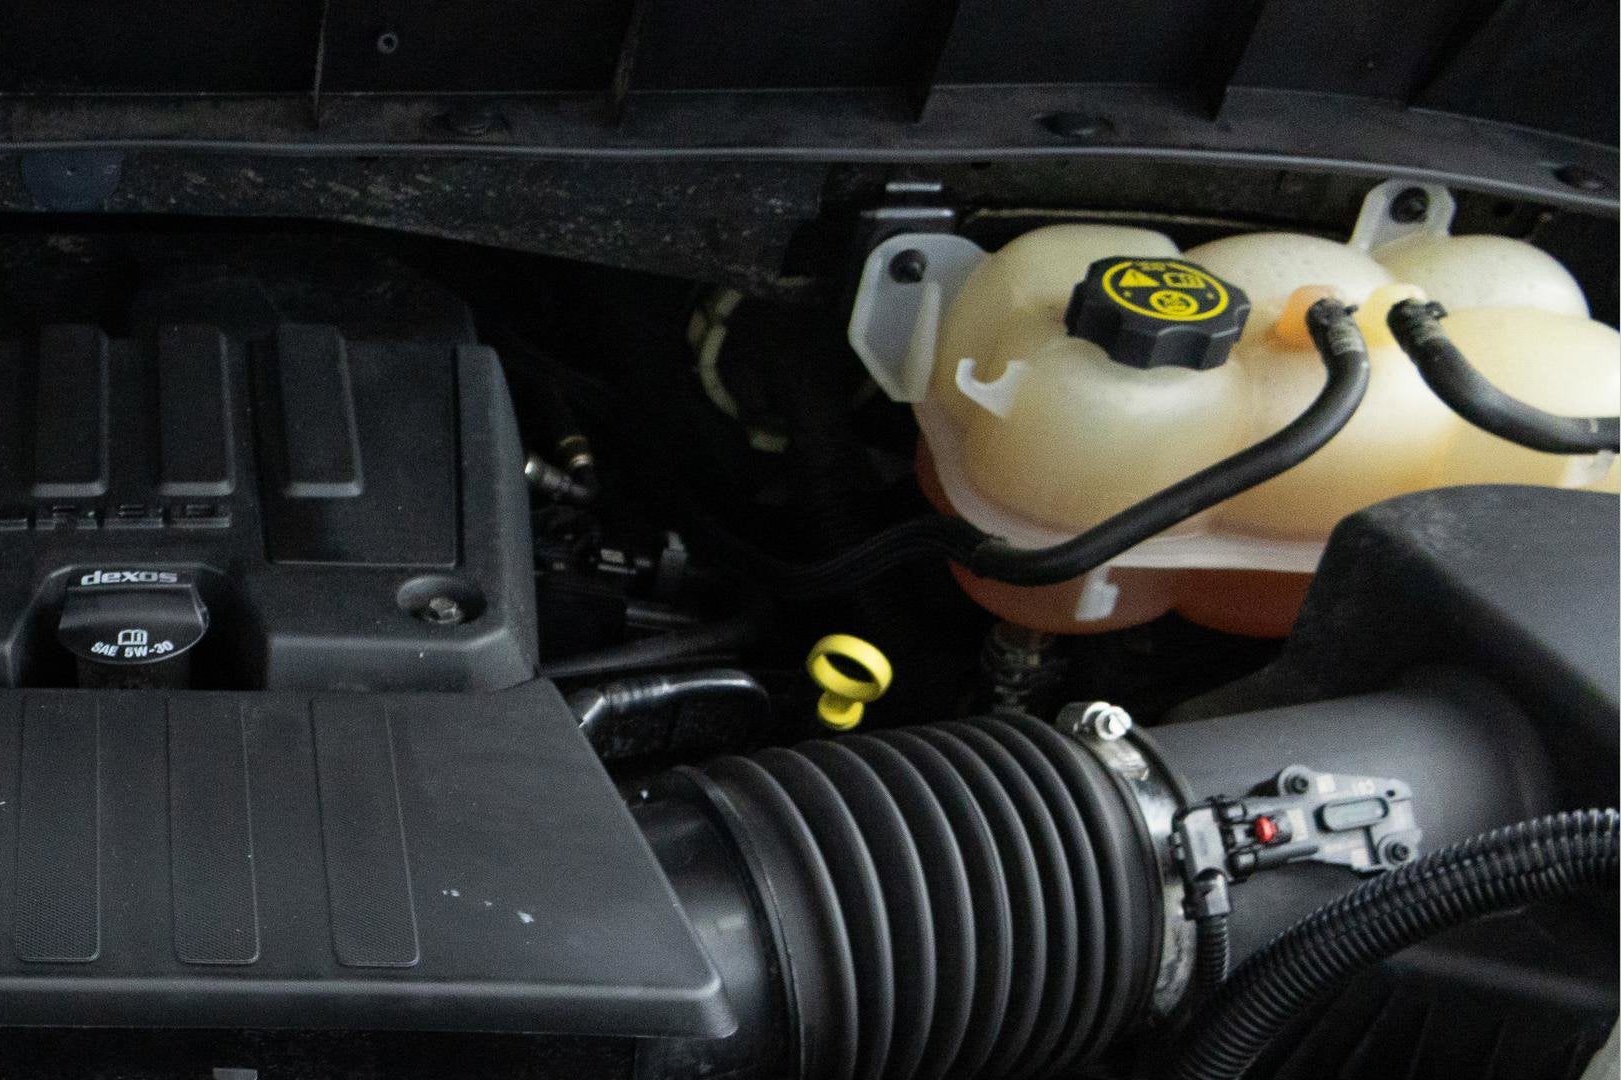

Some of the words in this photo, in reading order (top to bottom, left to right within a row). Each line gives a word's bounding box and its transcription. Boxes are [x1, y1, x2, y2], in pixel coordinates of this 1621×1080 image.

[80, 569, 179, 586] dexos
[90, 641, 120, 657] SAE
[124, 640, 175, 658] 5W-30
